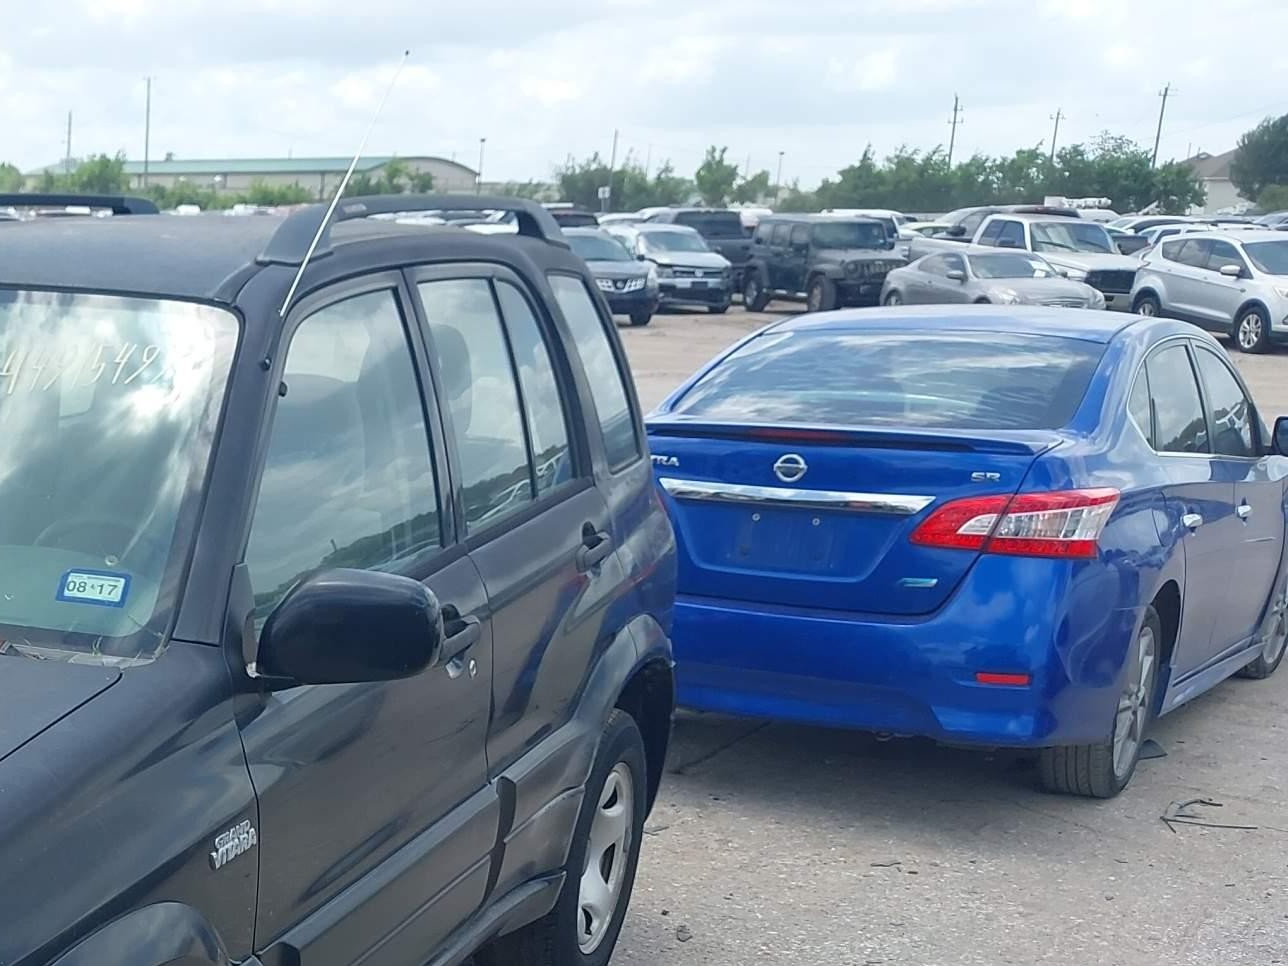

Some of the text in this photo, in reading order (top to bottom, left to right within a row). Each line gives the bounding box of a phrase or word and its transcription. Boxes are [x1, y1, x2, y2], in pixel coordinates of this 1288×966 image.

[971, 472, 1001, 482] SR
[66, 580, 118, 596] 08 17
